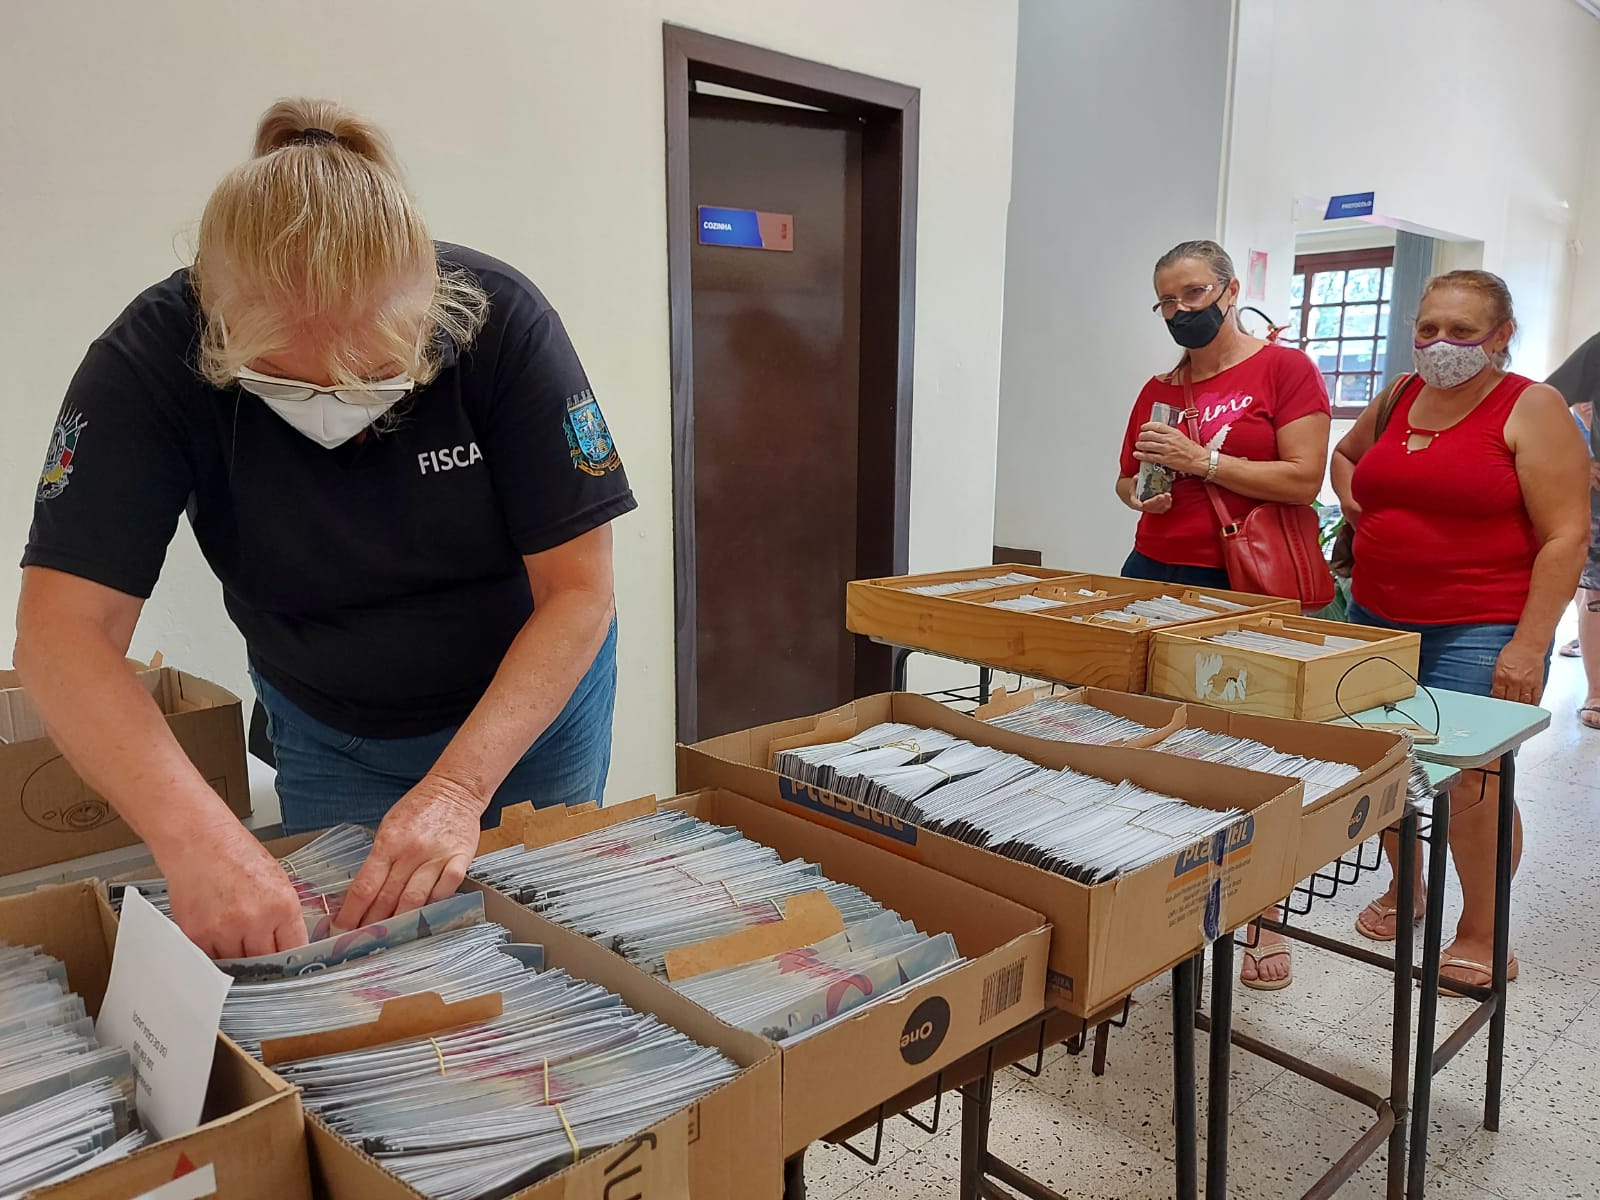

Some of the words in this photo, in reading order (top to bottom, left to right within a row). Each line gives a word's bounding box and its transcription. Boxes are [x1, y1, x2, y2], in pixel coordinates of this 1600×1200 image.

[703, 221, 732, 231] COZINHA
[418, 442, 483, 475] FISCA
[900, 1020, 934, 1048] One
